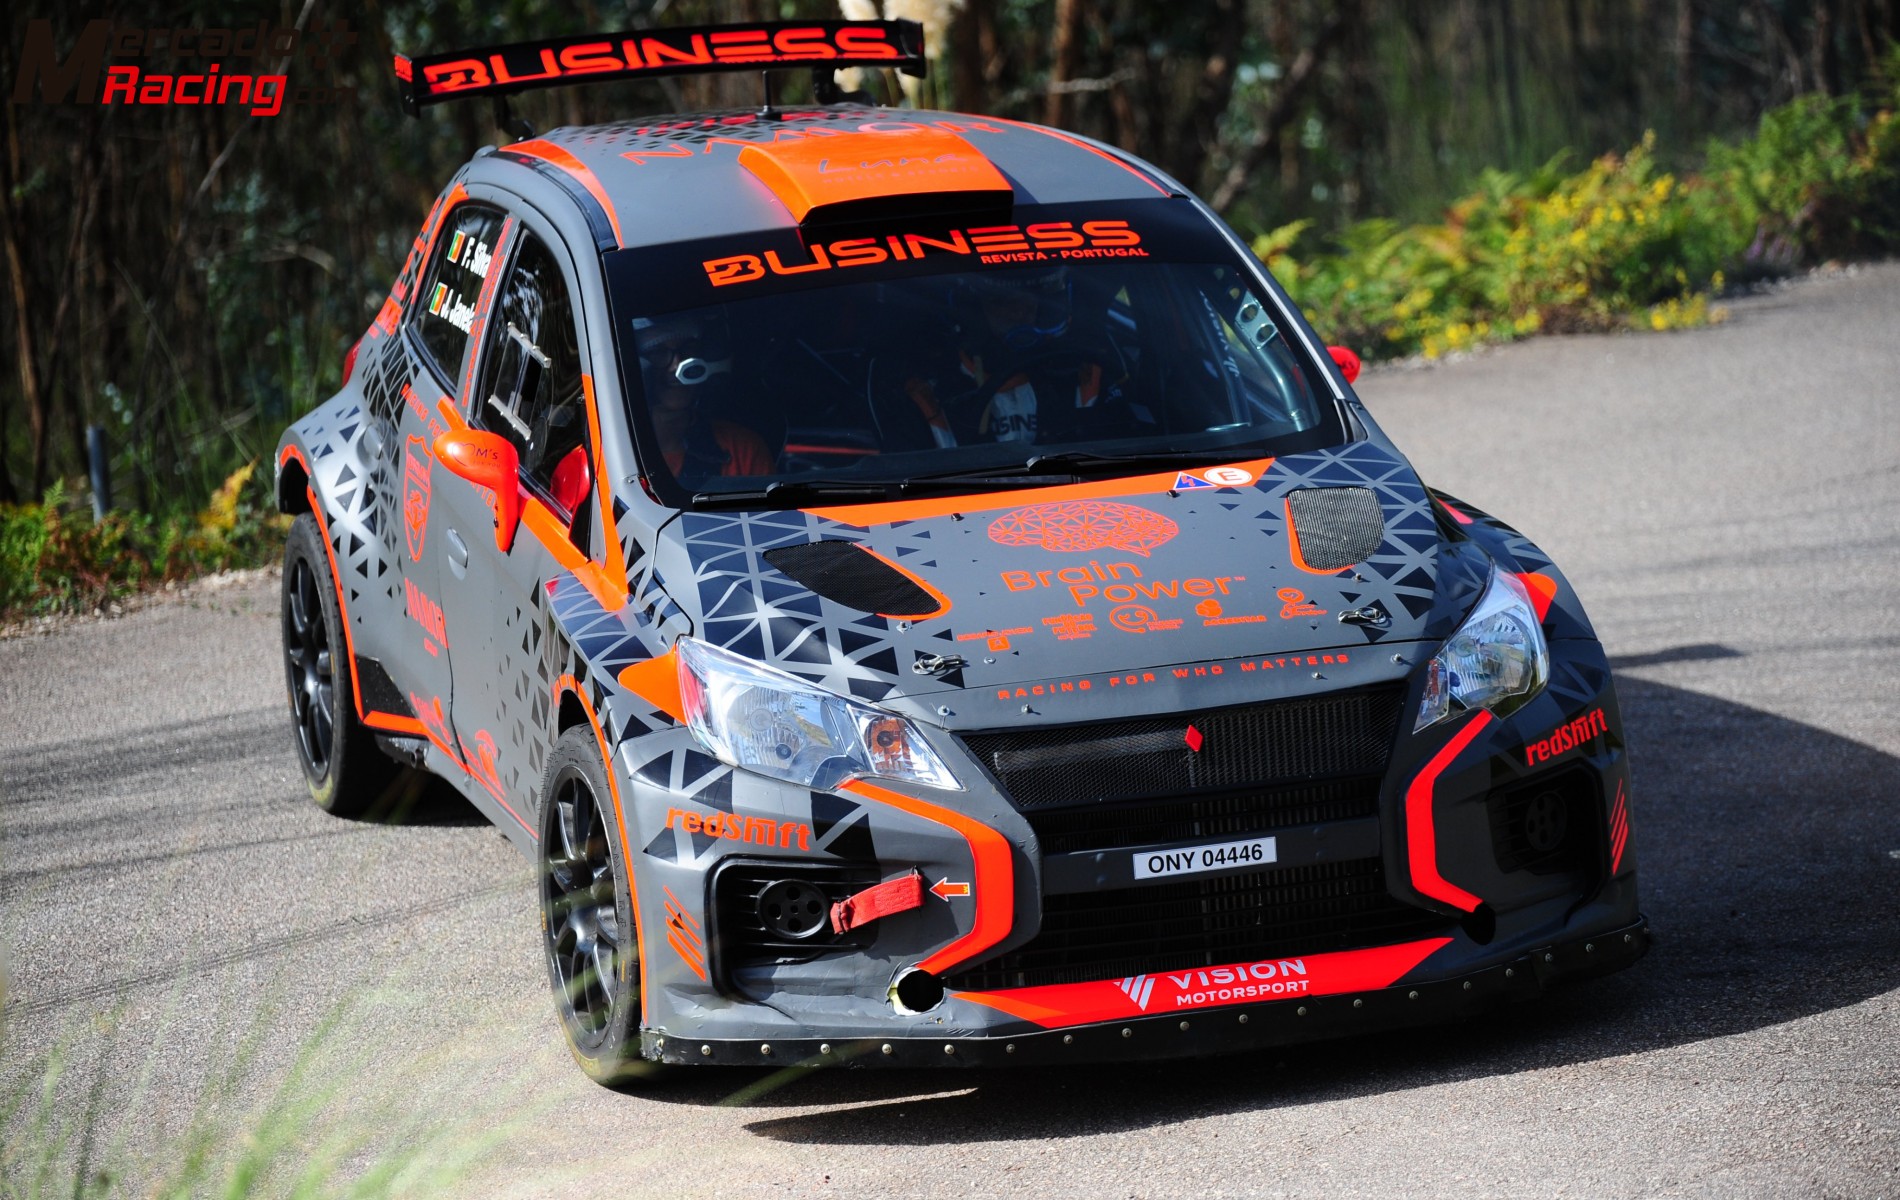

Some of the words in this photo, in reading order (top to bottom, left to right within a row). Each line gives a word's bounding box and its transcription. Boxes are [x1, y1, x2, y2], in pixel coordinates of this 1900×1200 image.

[423, 27, 900, 94] BUSINESS
[702, 220, 1142, 287] BUSINESS
[981, 251, 1048, 265] REVISTA
[1062, 246, 1149, 260] PORTUGAL
[1000, 560, 1143, 592] Brain
[1068, 577, 1231, 607] Power
[998, 680, 1091, 699] RACING
[1110, 672, 1155, 687] FOR
[1172, 665, 1224, 679] WHO
[1241, 654, 1349, 672] MATTERS
[1148, 851, 1196, 873] ONY
[1202, 844, 1263, 867] 04446
[1167, 959, 1307, 989] VISION
[1176, 980, 1310, 1006] MOTORSPORT
